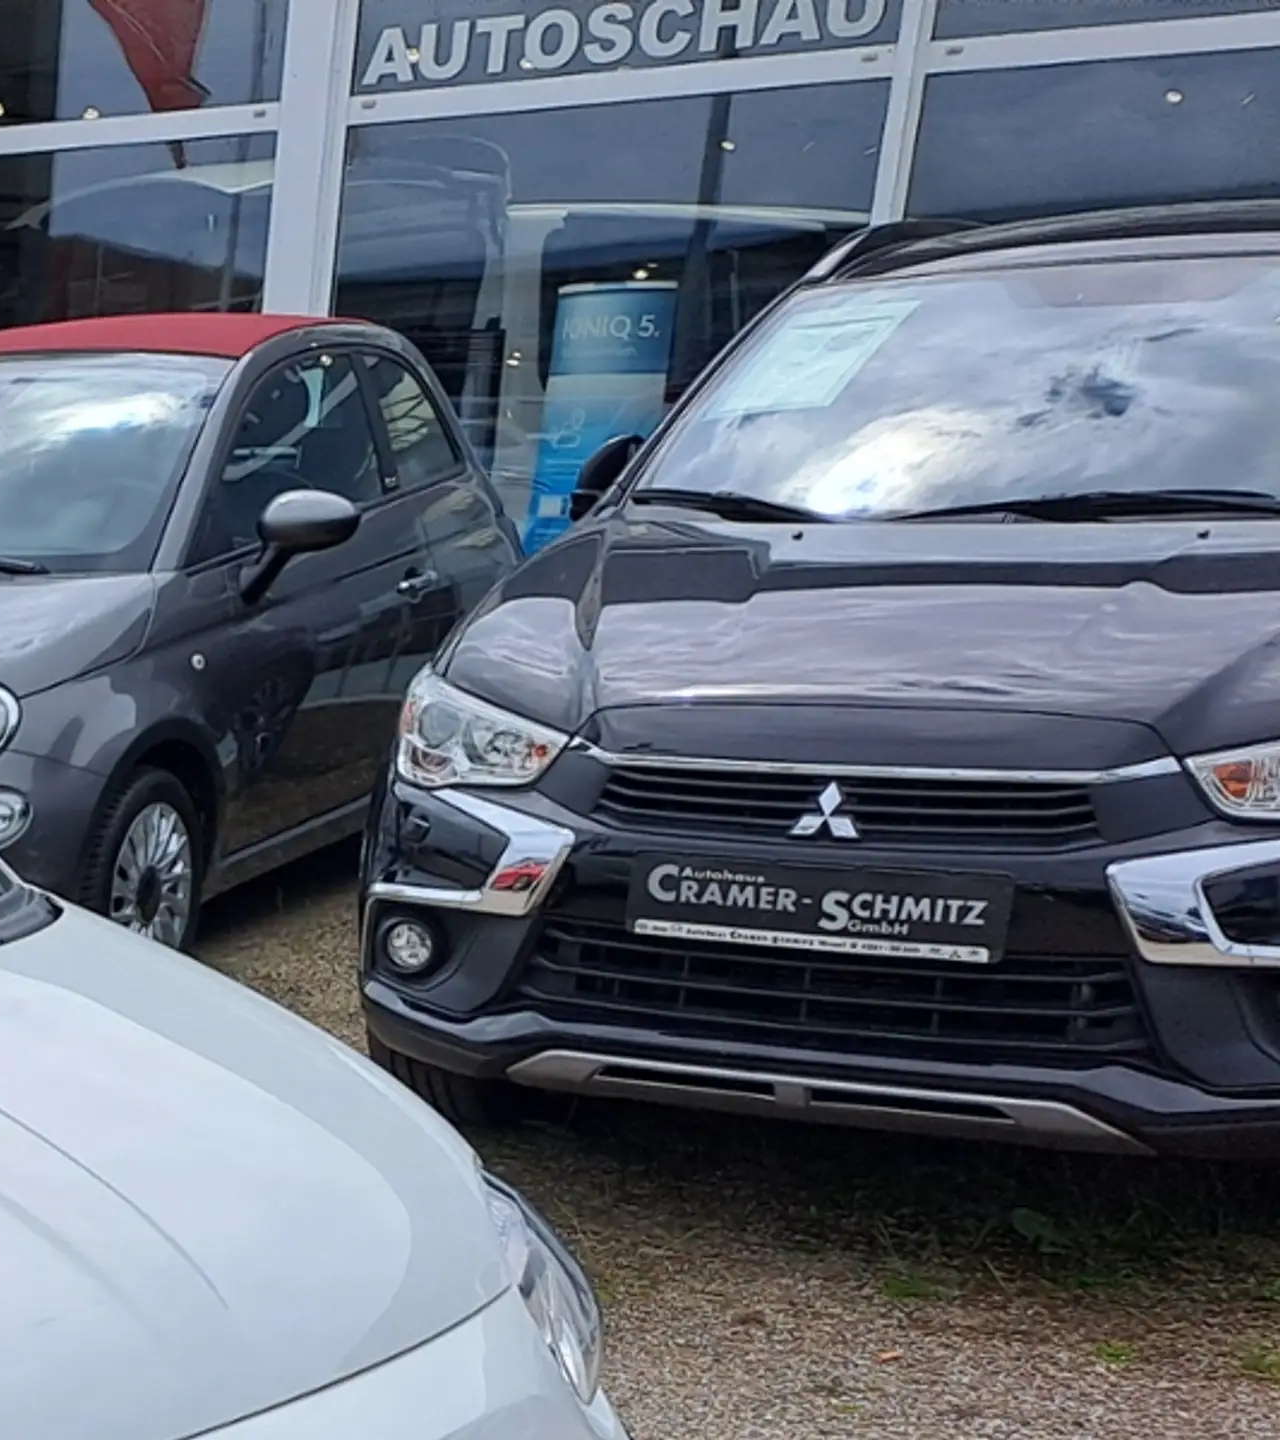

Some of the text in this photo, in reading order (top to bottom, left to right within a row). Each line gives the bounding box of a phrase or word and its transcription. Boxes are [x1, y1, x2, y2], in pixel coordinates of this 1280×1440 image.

[361, 0, 882, 86] AUTOSCHAU
[680, 867, 766, 884] Autohaus
[847, 919, 910, 936] GmbH
